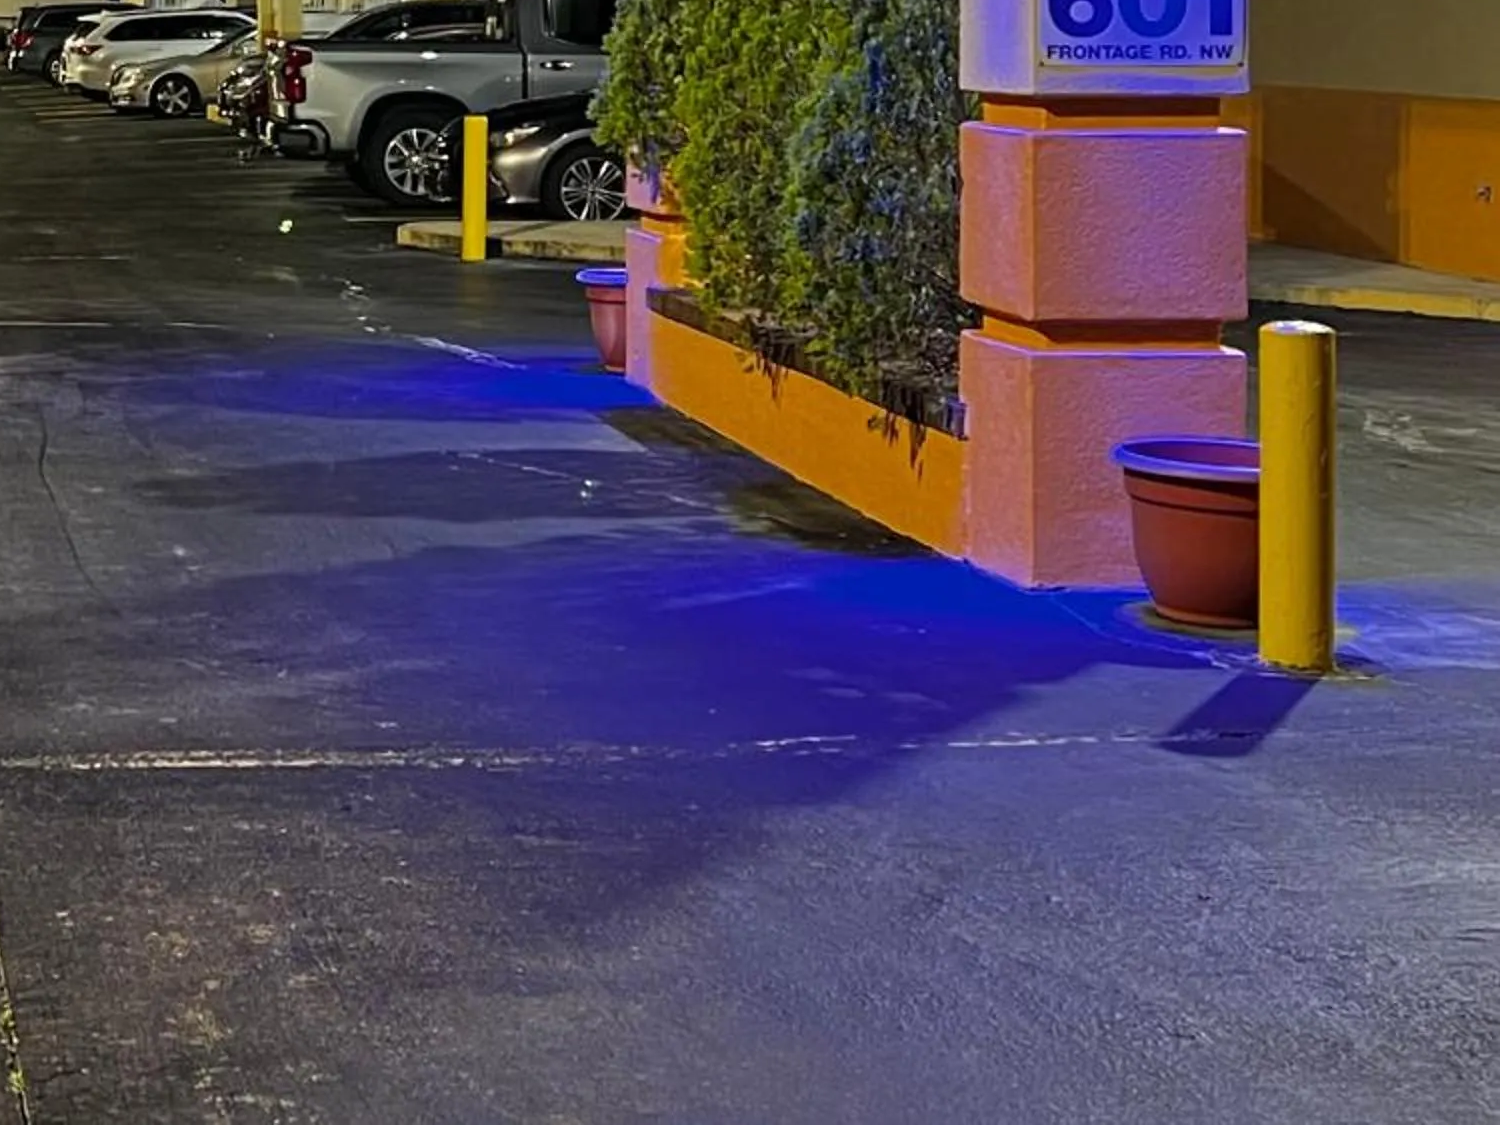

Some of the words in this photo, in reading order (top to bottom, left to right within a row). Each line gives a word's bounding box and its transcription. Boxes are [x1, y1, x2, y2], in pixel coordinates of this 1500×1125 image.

[1046, 44, 1152, 60] FRONTAGE
[1159, 44, 1192, 60] RD.
[1200, 44, 1234, 60] NW
